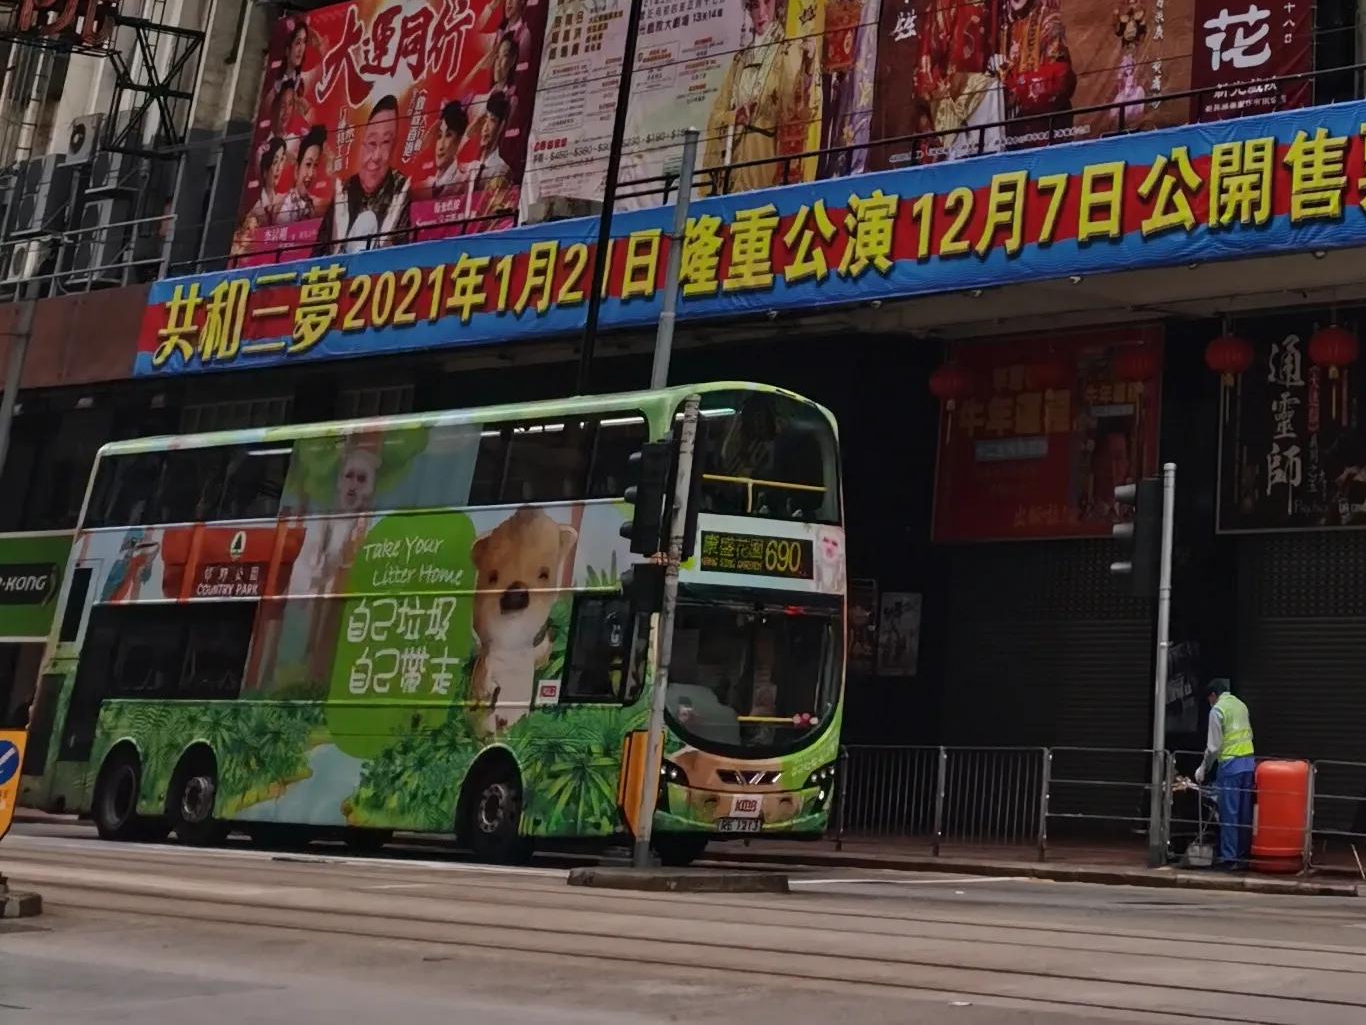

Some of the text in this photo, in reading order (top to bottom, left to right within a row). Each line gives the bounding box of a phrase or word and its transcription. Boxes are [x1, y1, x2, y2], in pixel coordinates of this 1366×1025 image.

[1265, 333, 1305, 516] 通靈師
[362, 535, 445, 564] Take Your
[764, 539, 802, 573] 690
[235, 582, 259, 596] PARK
[372, 562, 465, 587] Litter Home
[346, 595, 457, 643] 自己垃圾
[349, 646, 461, 695] 自己帶走
